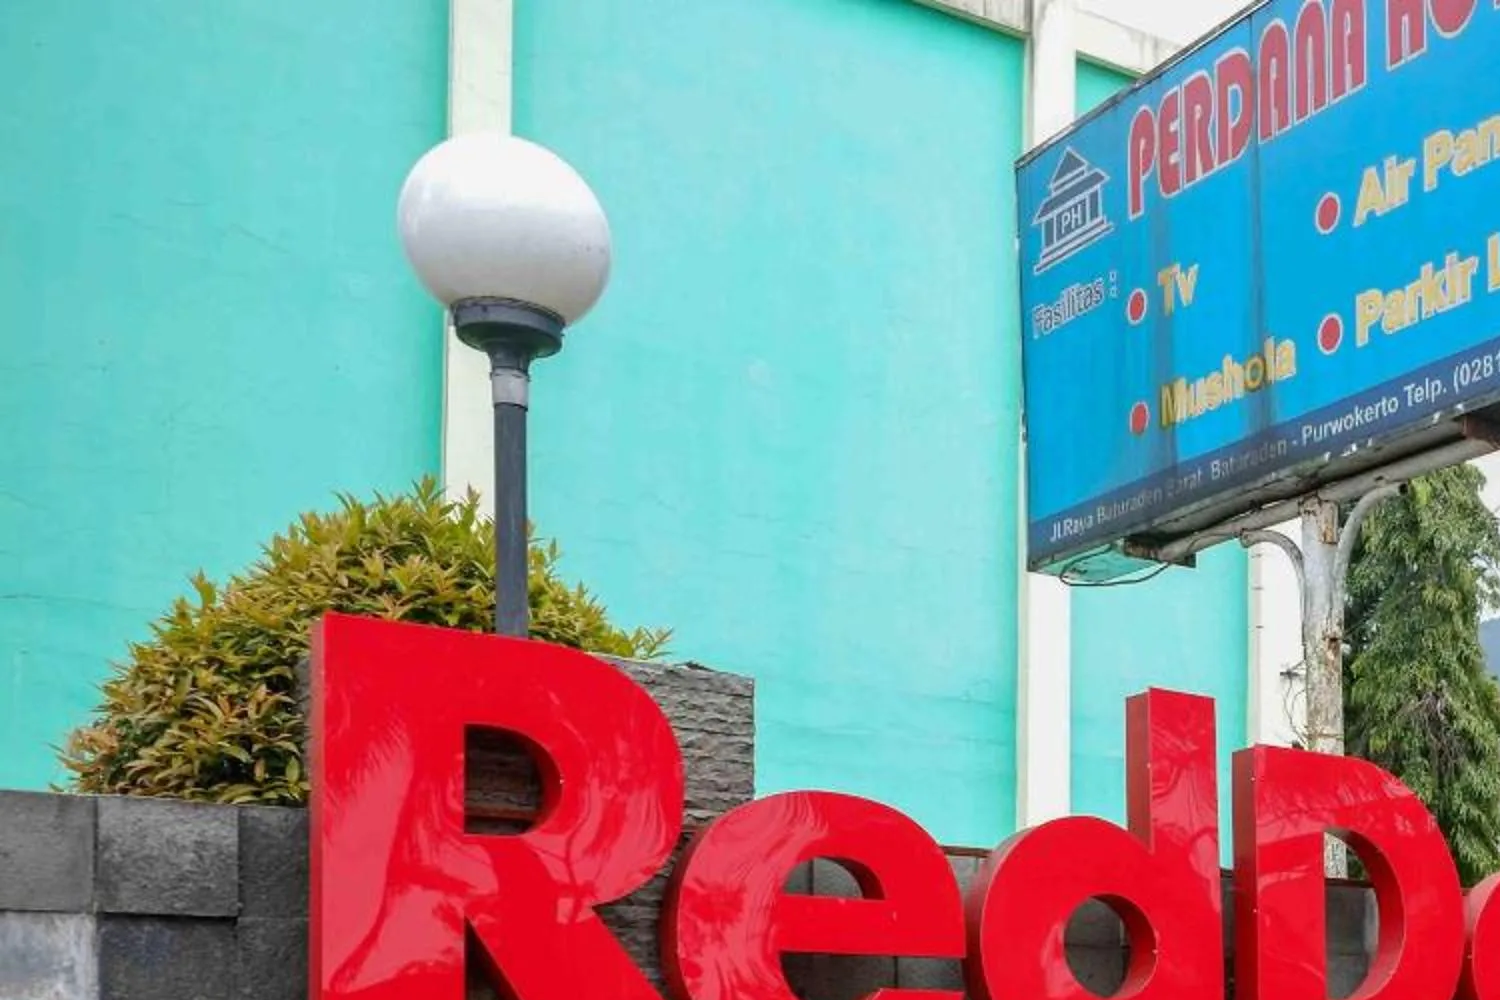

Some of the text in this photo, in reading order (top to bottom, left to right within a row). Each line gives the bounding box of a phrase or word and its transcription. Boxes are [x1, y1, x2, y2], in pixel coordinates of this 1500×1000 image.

[1128, 0, 1368, 221] PERDANA
[1060, 205, 1083, 235] PH
[1353, 155, 1416, 227] Air
[1033, 278, 1104, 340] Fasilitas
[1158, 262, 1200, 317] Tv
[1356, 251, 1479, 347] Parkir
[1160, 335, 1297, 430] Mushola
[1301, 393, 1400, 446] Purwokerto
[1404, 377, 1448, 409] Telp.
